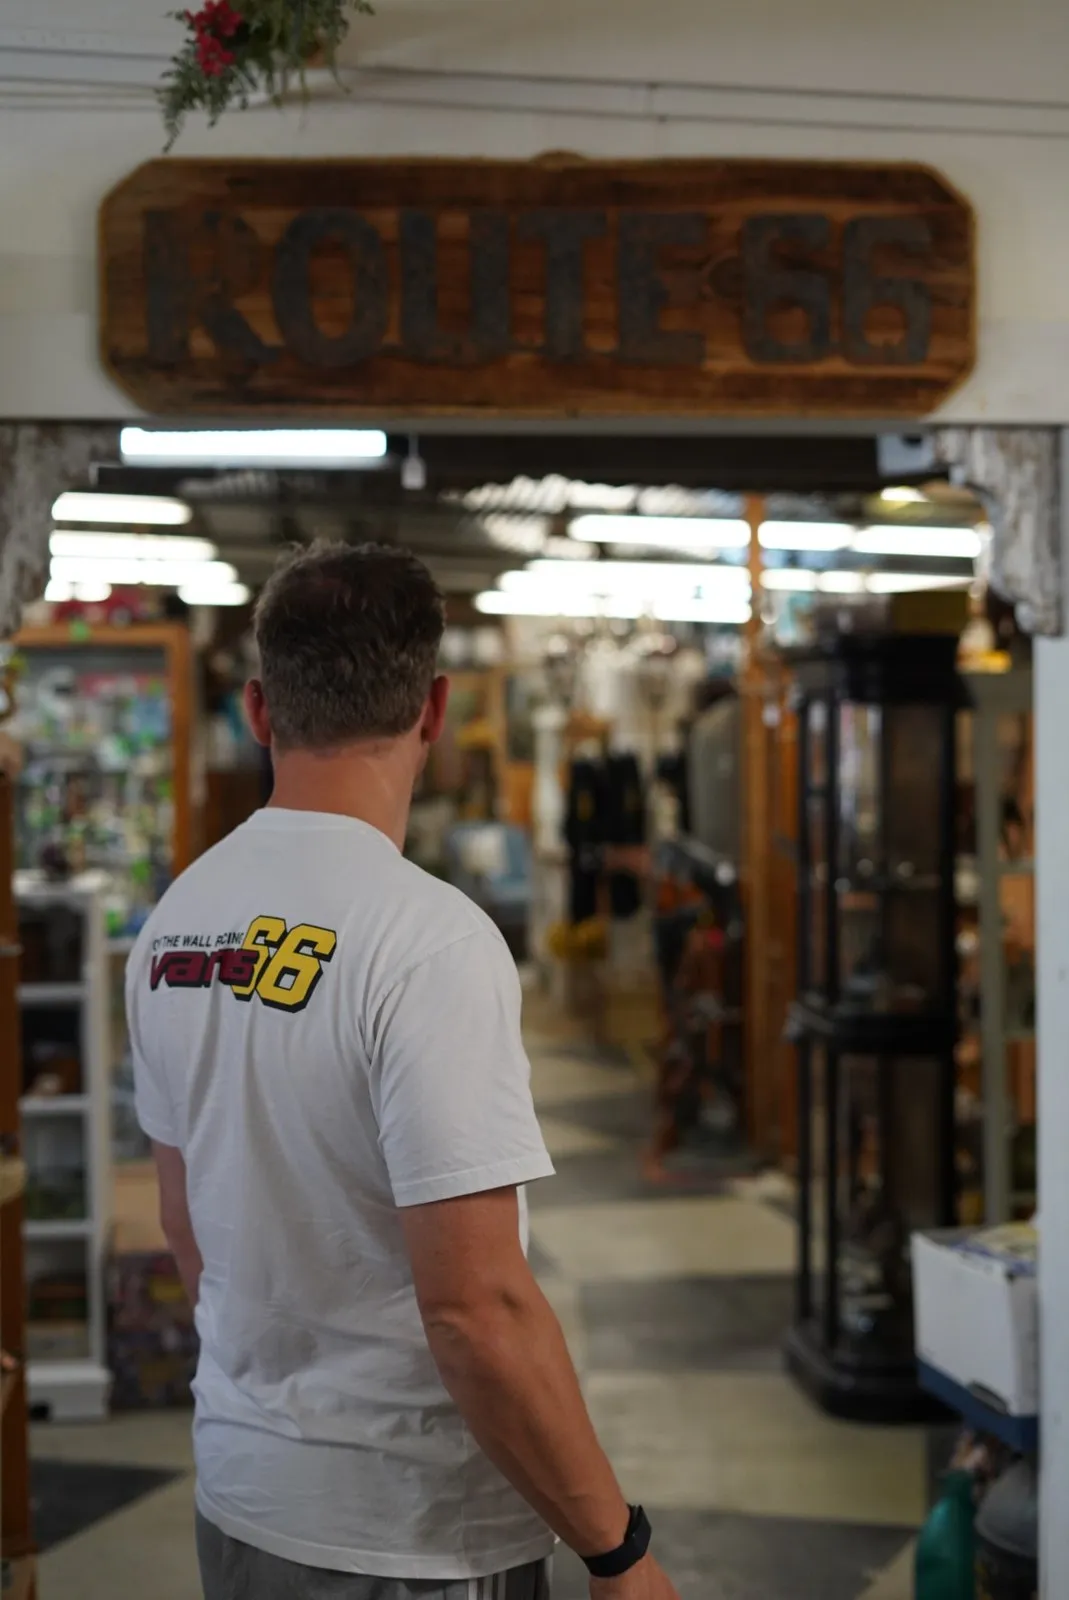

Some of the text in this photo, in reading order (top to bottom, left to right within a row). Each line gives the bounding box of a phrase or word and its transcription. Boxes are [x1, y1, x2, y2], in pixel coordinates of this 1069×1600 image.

[141, 206, 934, 368] ROUTE 66
[163, 934, 181, 948] THE
[183, 934, 212, 948] WALL
[232, 915, 337, 1013] 66
